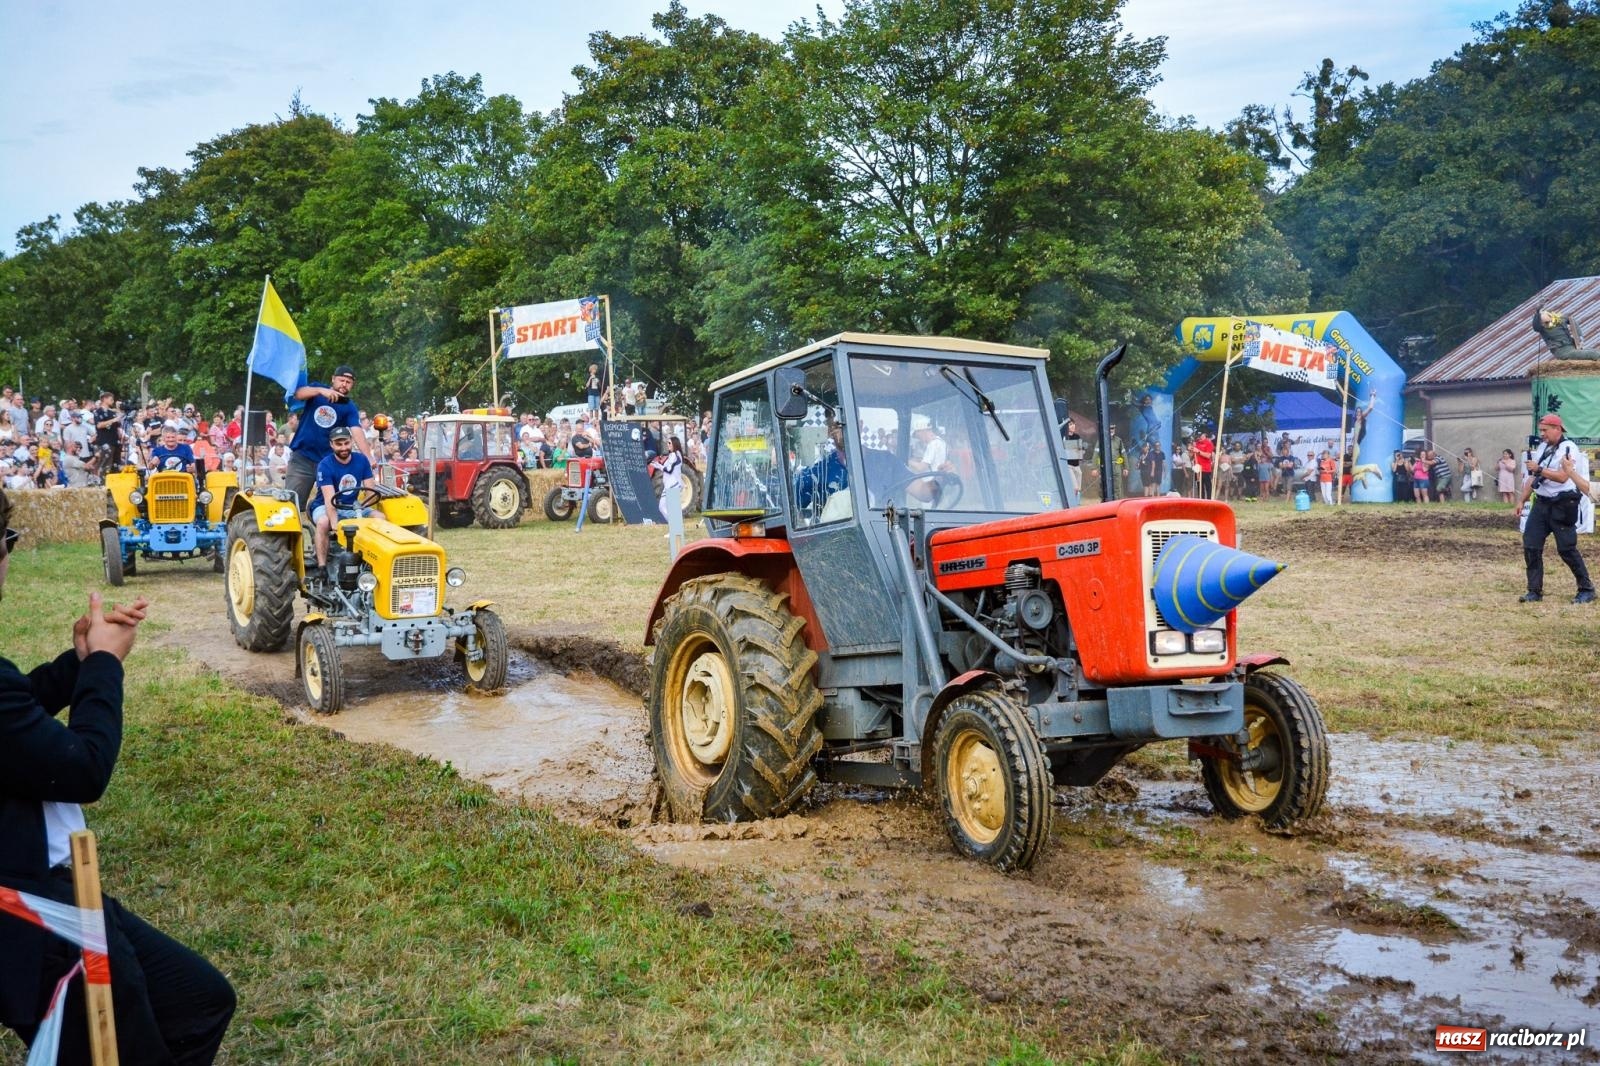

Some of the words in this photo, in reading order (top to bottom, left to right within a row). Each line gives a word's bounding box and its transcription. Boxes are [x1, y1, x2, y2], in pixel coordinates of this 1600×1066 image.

[516, 315, 581, 344] START
[1260, 341, 1325, 372] META
[1352, 353, 1374, 376] ludzi
[1058, 543, 1085, 557] C-360
[1087, 541, 1099, 554] 3P
[939, 558, 985, 573] URSUS
